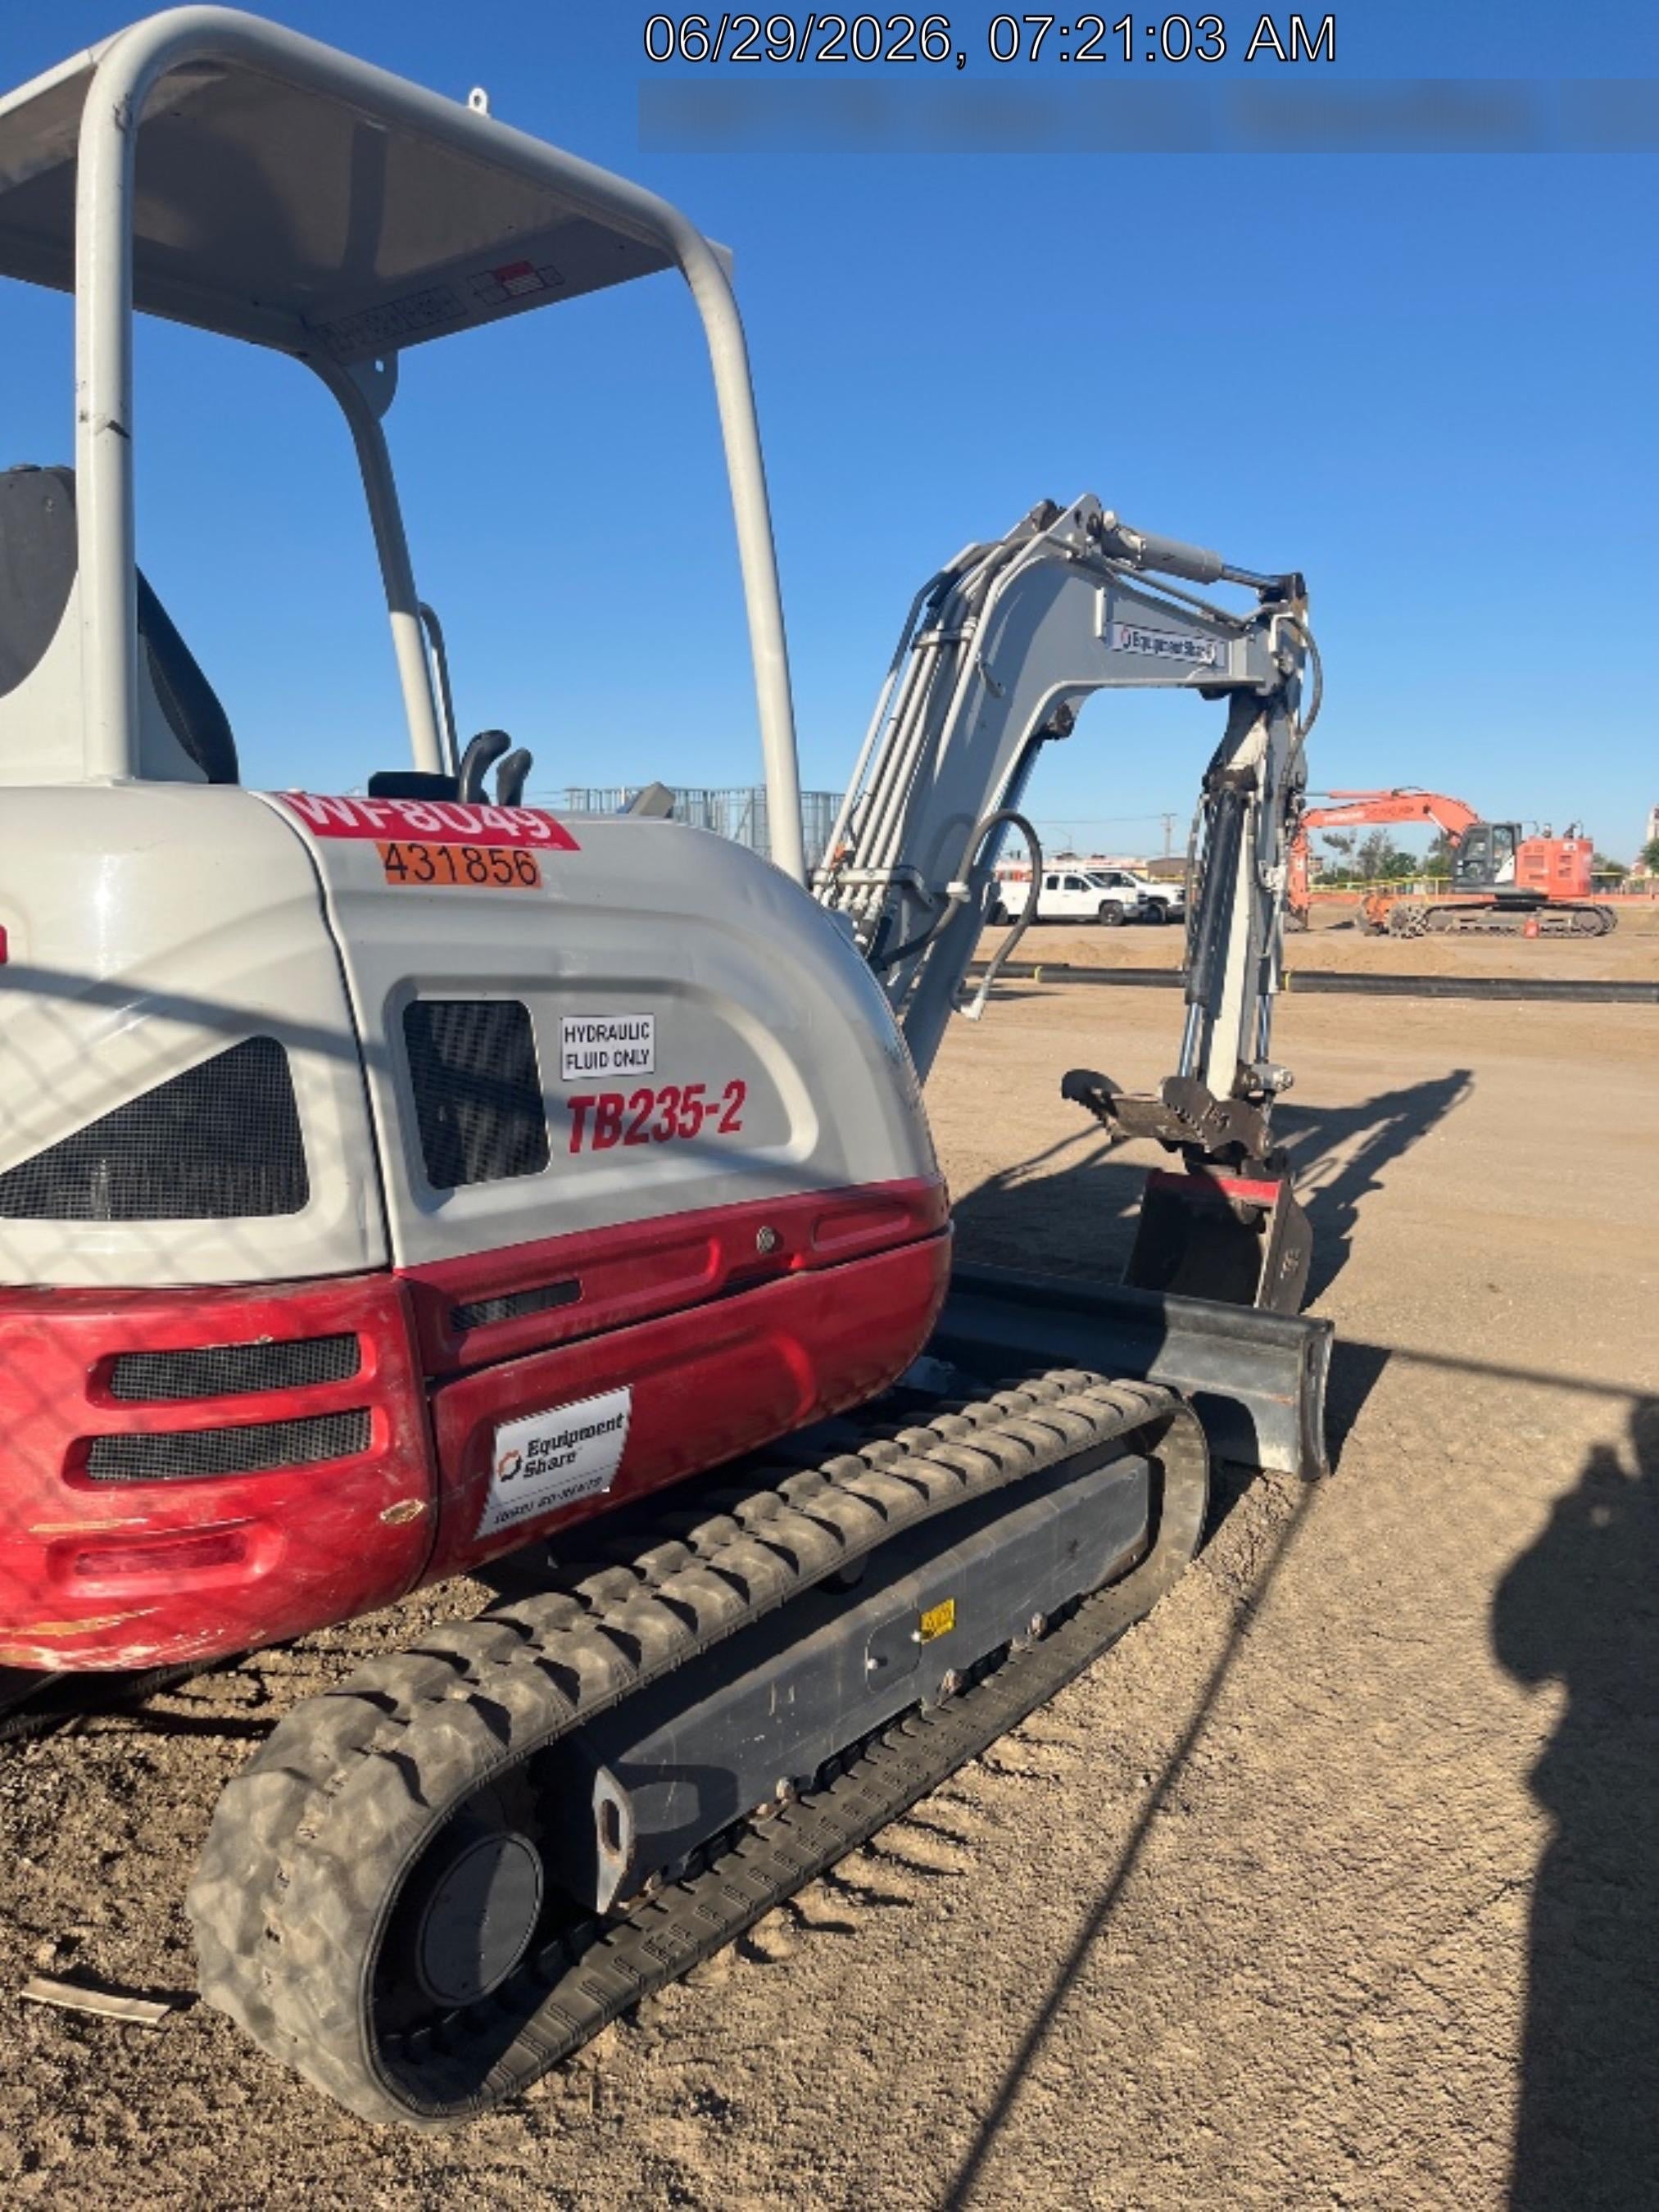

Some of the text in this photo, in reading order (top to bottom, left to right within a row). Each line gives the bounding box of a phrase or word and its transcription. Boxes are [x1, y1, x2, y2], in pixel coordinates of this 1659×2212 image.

[384, 843, 537, 885] 431856
[564, 1022, 650, 1042] HYDRAULIC
[566, 1049, 650, 1070] FLUID ONLY
[567, 1078, 746, 1154] TB235-2
[527, 1412, 624, 1457] Equipment
[523, 1452, 577, 1479] Share
